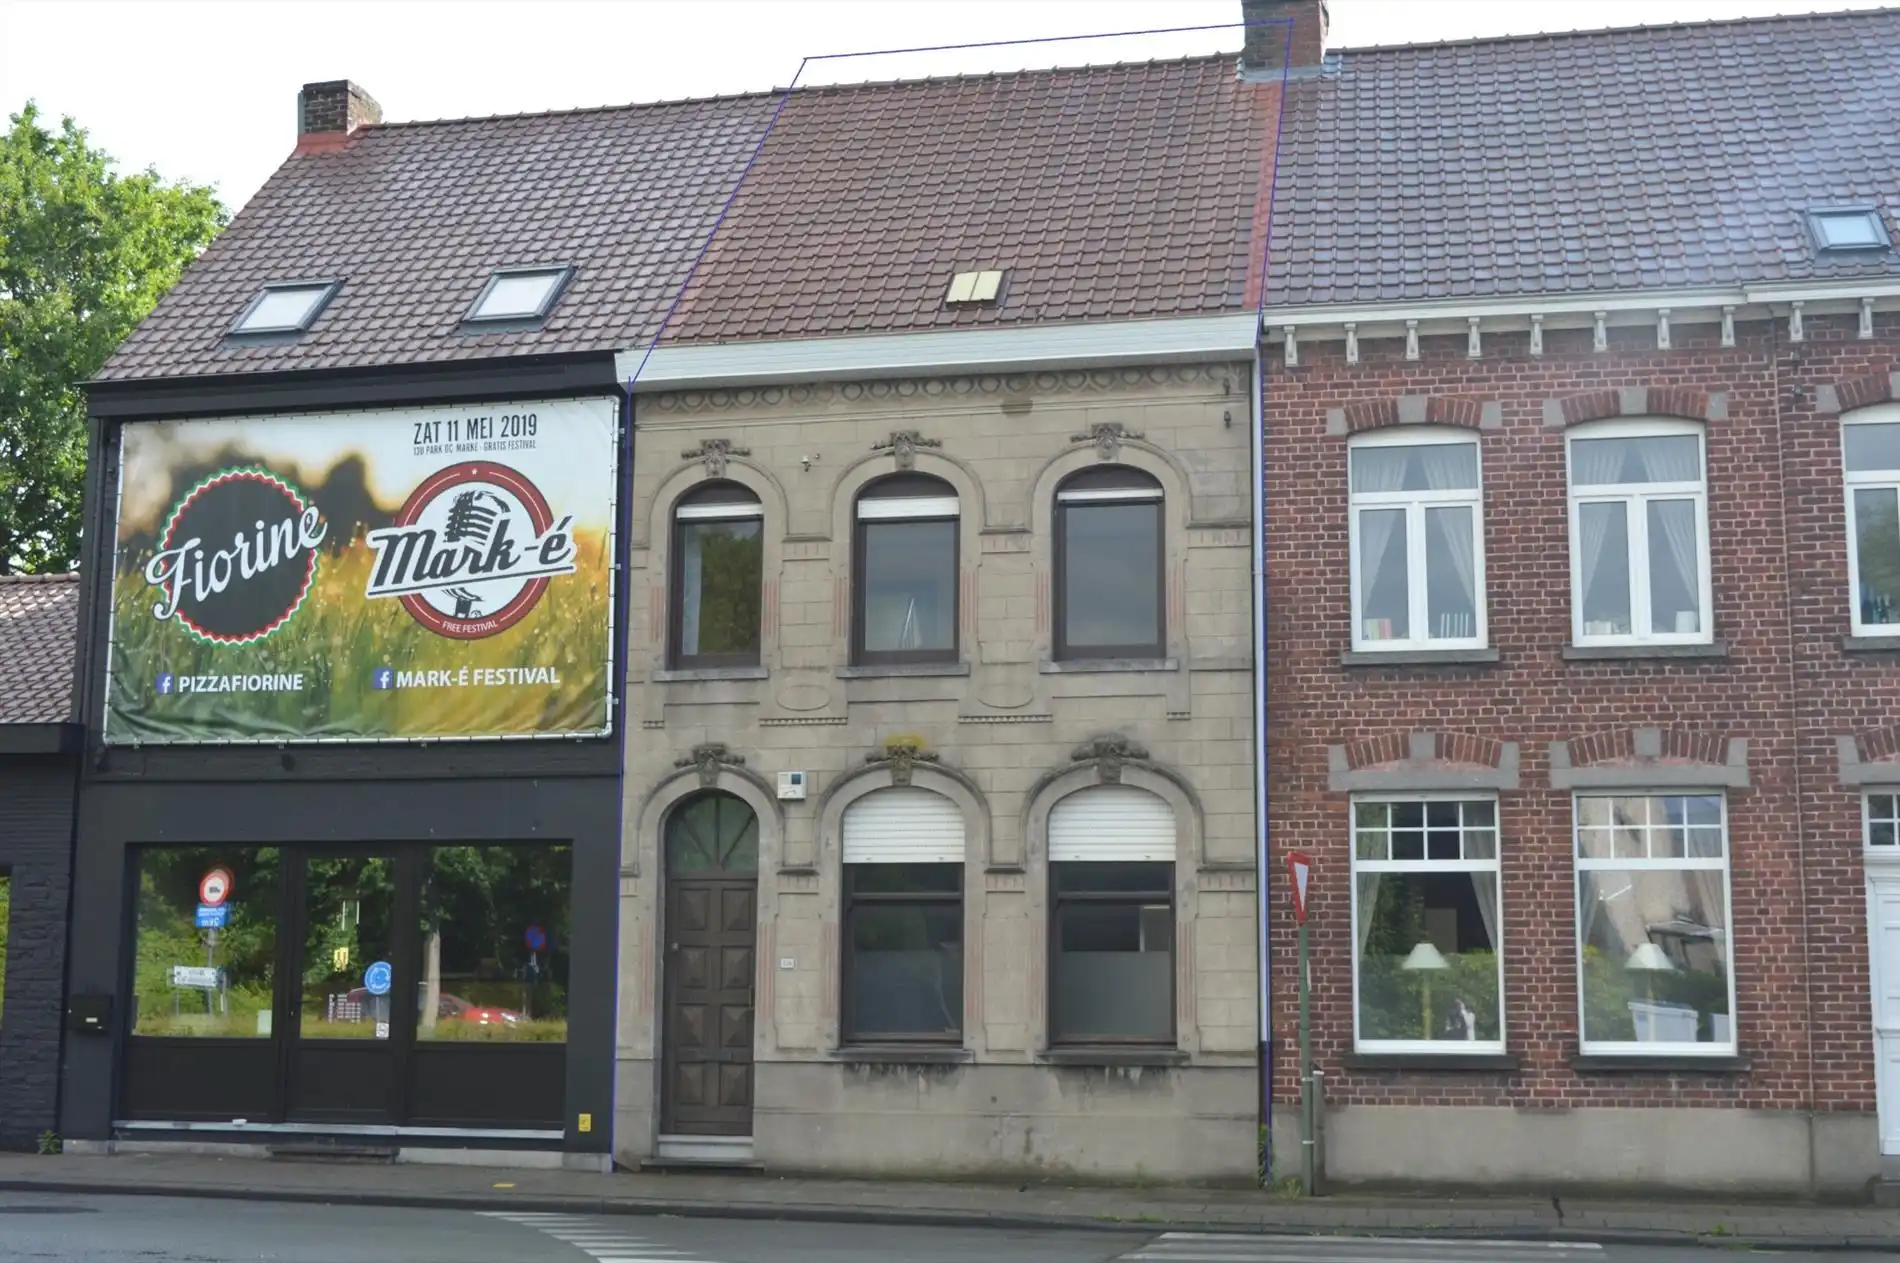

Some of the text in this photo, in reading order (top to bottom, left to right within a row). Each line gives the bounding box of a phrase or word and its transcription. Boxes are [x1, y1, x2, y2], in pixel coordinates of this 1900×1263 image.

[414, 413, 537, 444] ZAT 11 MEI 2019
[426, 444, 442, 454] PARK
[484, 440, 506, 451] GRATIS
[508, 440, 536, 450] FESTIVAL
[372, 515, 573, 587] Mark-é
[145, 506, 328, 620] Fiorine
[442, 620, 499, 633] FREE FESTIVAL
[179, 674, 303, 692] PIZZAFIORINE
[396, 666, 469, 688] MARK-É
[473, 667, 560, 686] FESTIVAL
